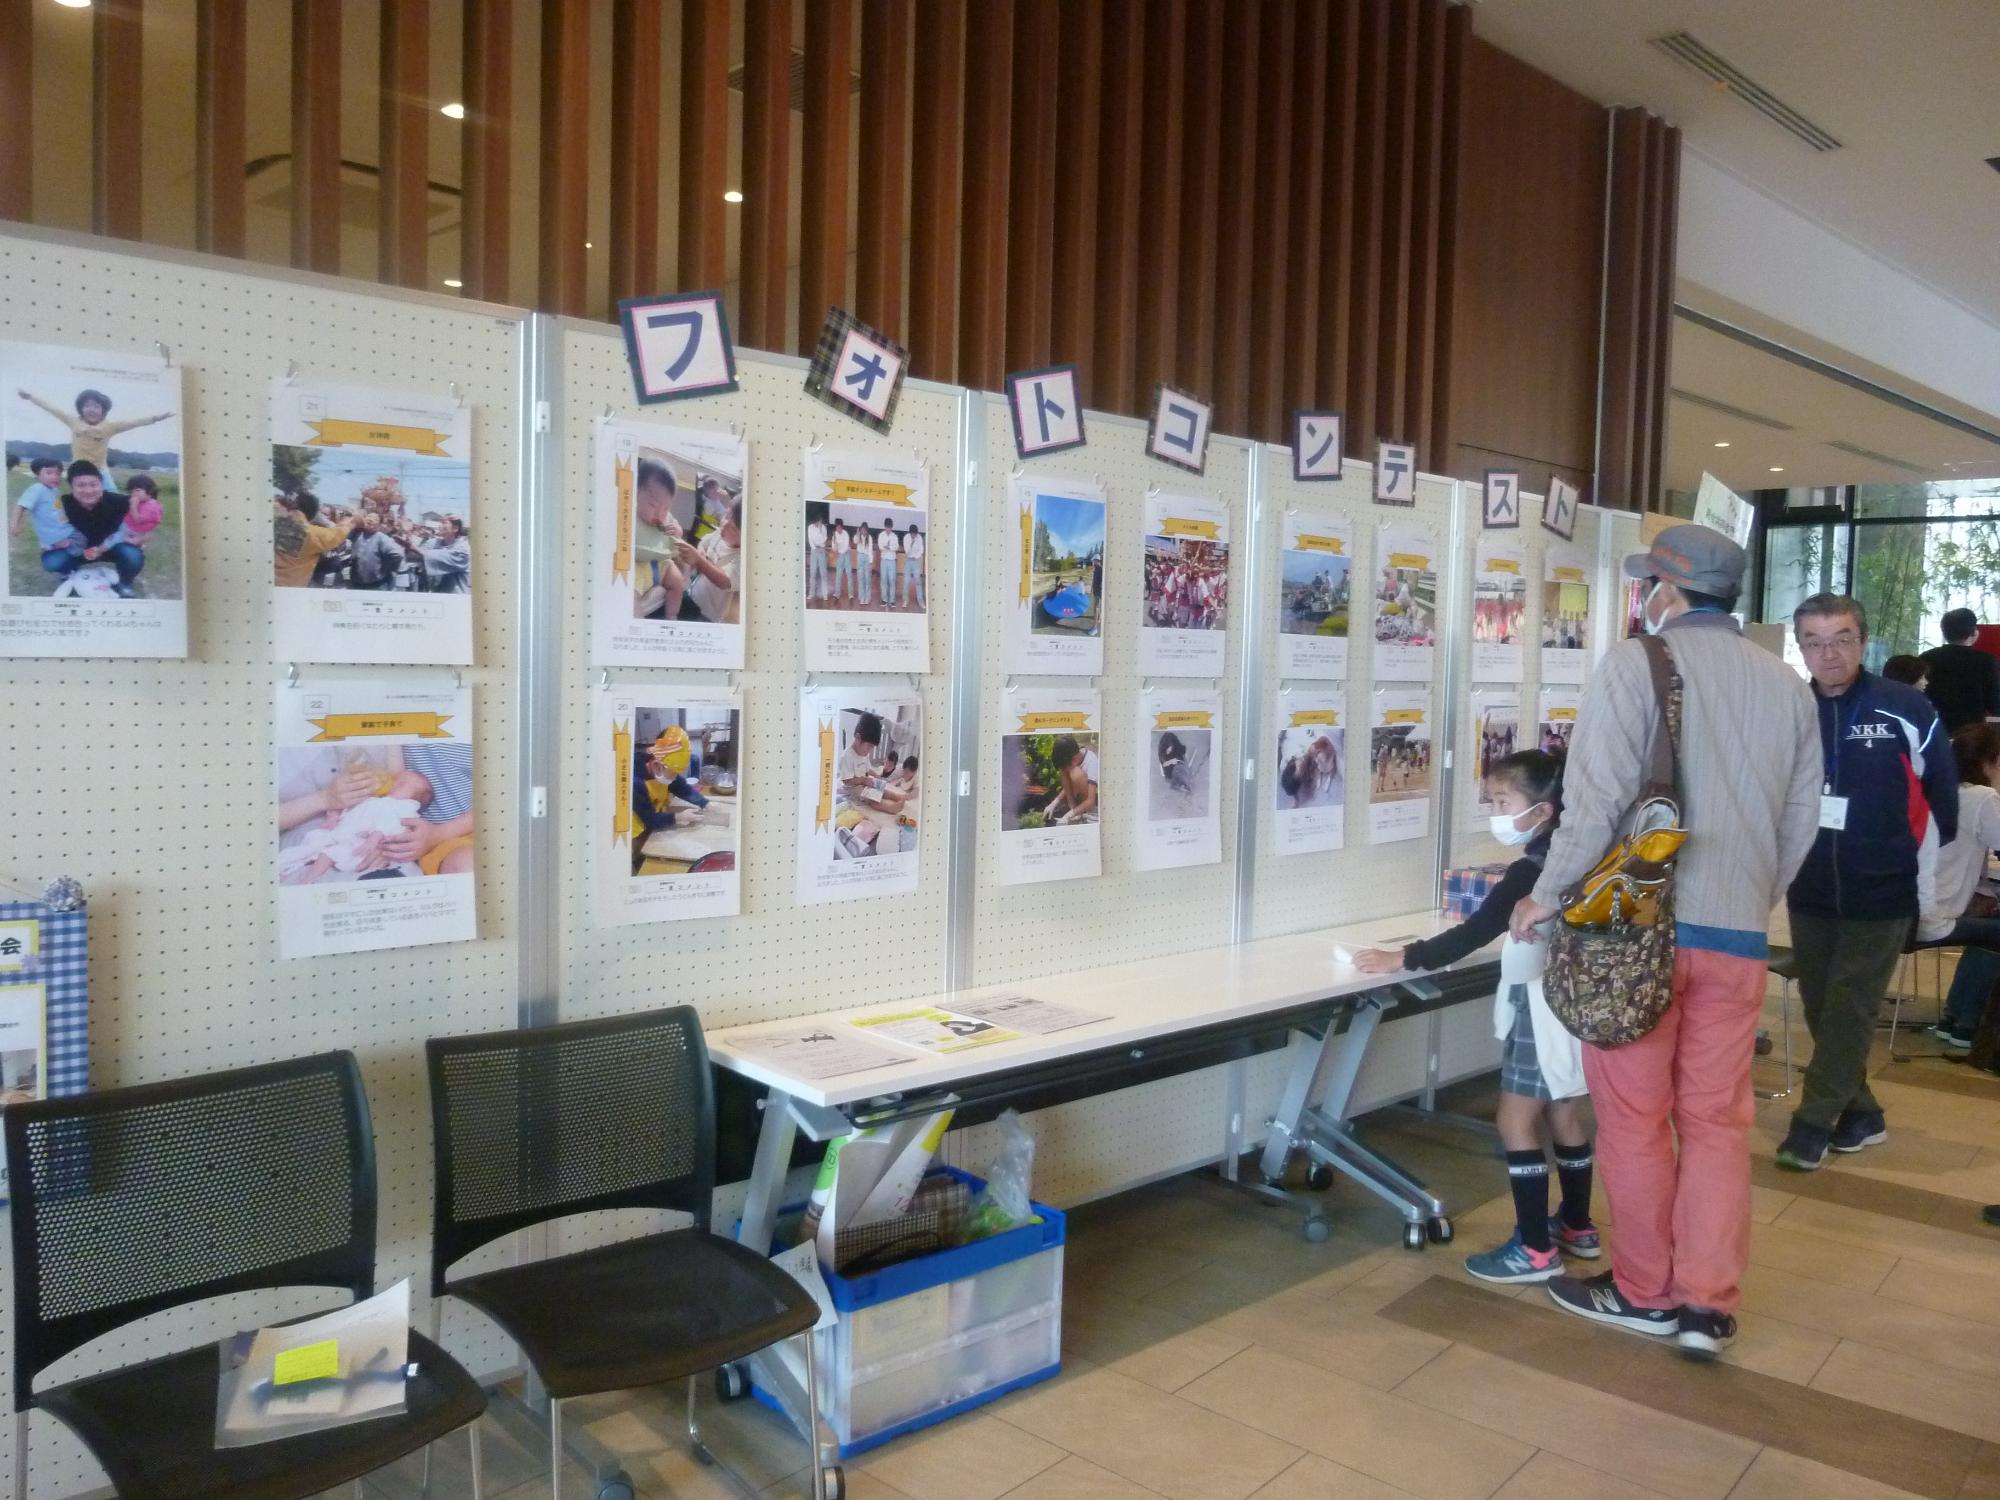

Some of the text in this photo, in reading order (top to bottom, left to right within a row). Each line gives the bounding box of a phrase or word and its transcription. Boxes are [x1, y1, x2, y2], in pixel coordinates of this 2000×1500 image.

[647, 310, 704, 382] フ
[1033, 382, 1066, 442] ト
[1163, 403, 1199, 454] コ
[1305, 421, 1334, 469] ン
[1384, 449, 1408, 494] テ
[1493, 479, 1513, 518] ス
[1850, 723, 1889, 735] NKK
[1864, 739, 1873, 748] 4
[0, 936, 22, 956] 会
[1589, 1288, 1623, 1313] N
